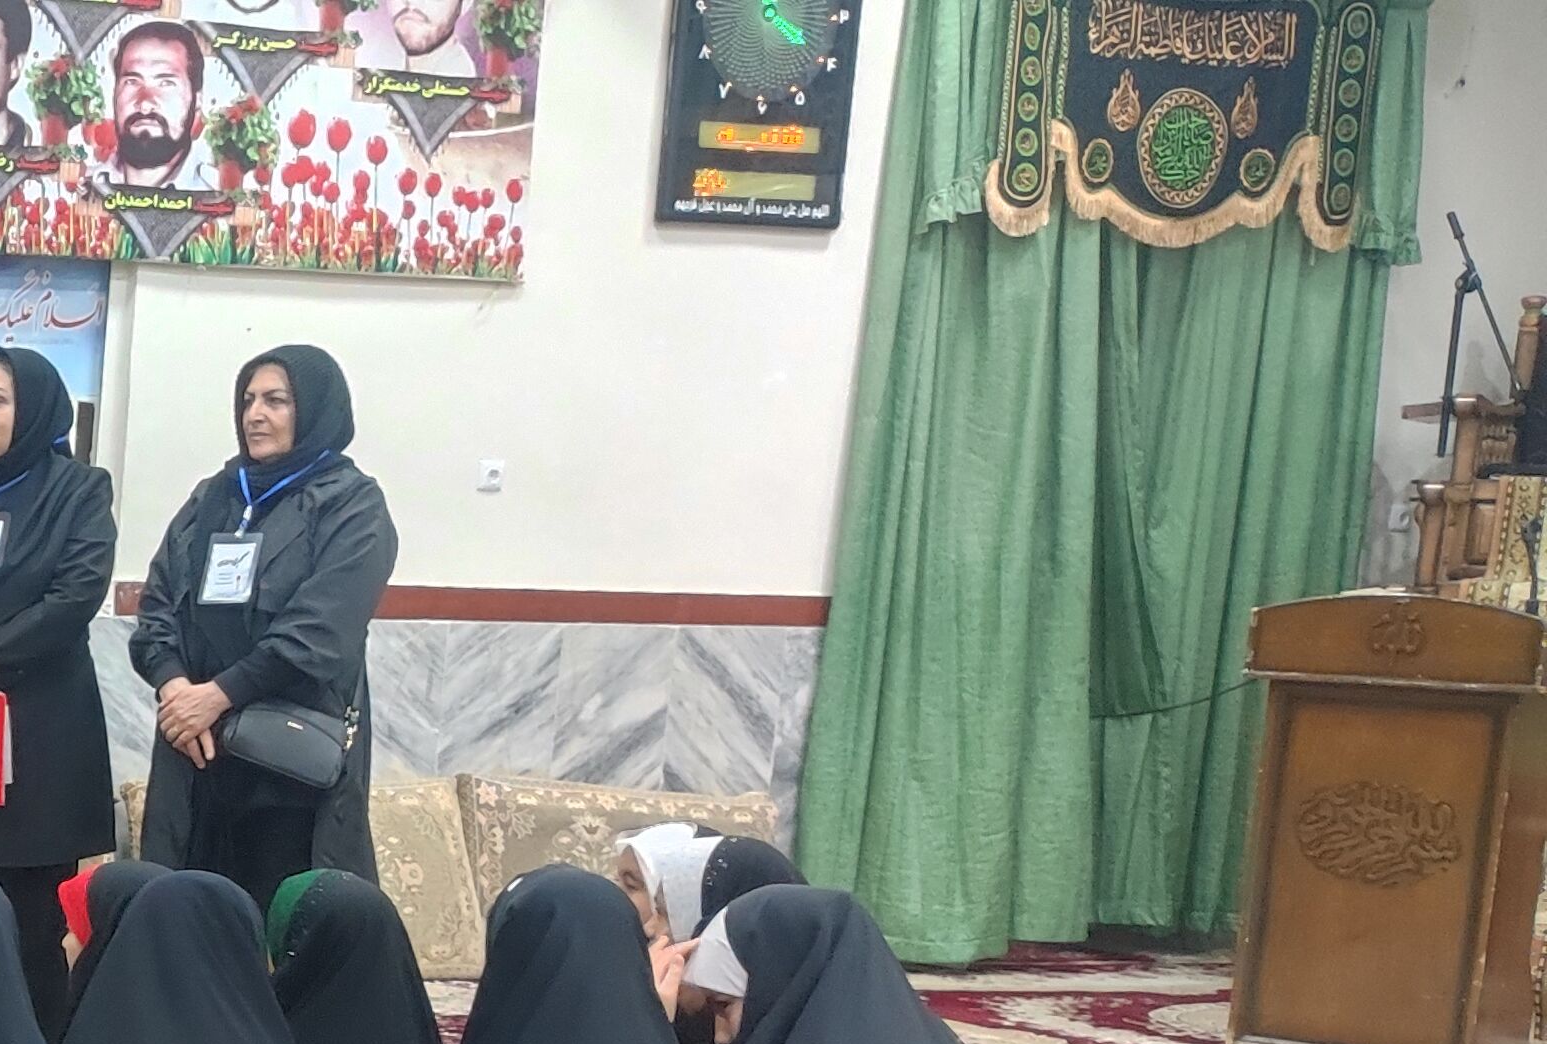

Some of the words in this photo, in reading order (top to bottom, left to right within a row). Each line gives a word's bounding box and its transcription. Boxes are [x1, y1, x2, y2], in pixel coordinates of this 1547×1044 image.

[259, 36, 297, 52] حسین
[104, 191, 158, 210] احمدیان
[159, 196, 193, 210] احمد
